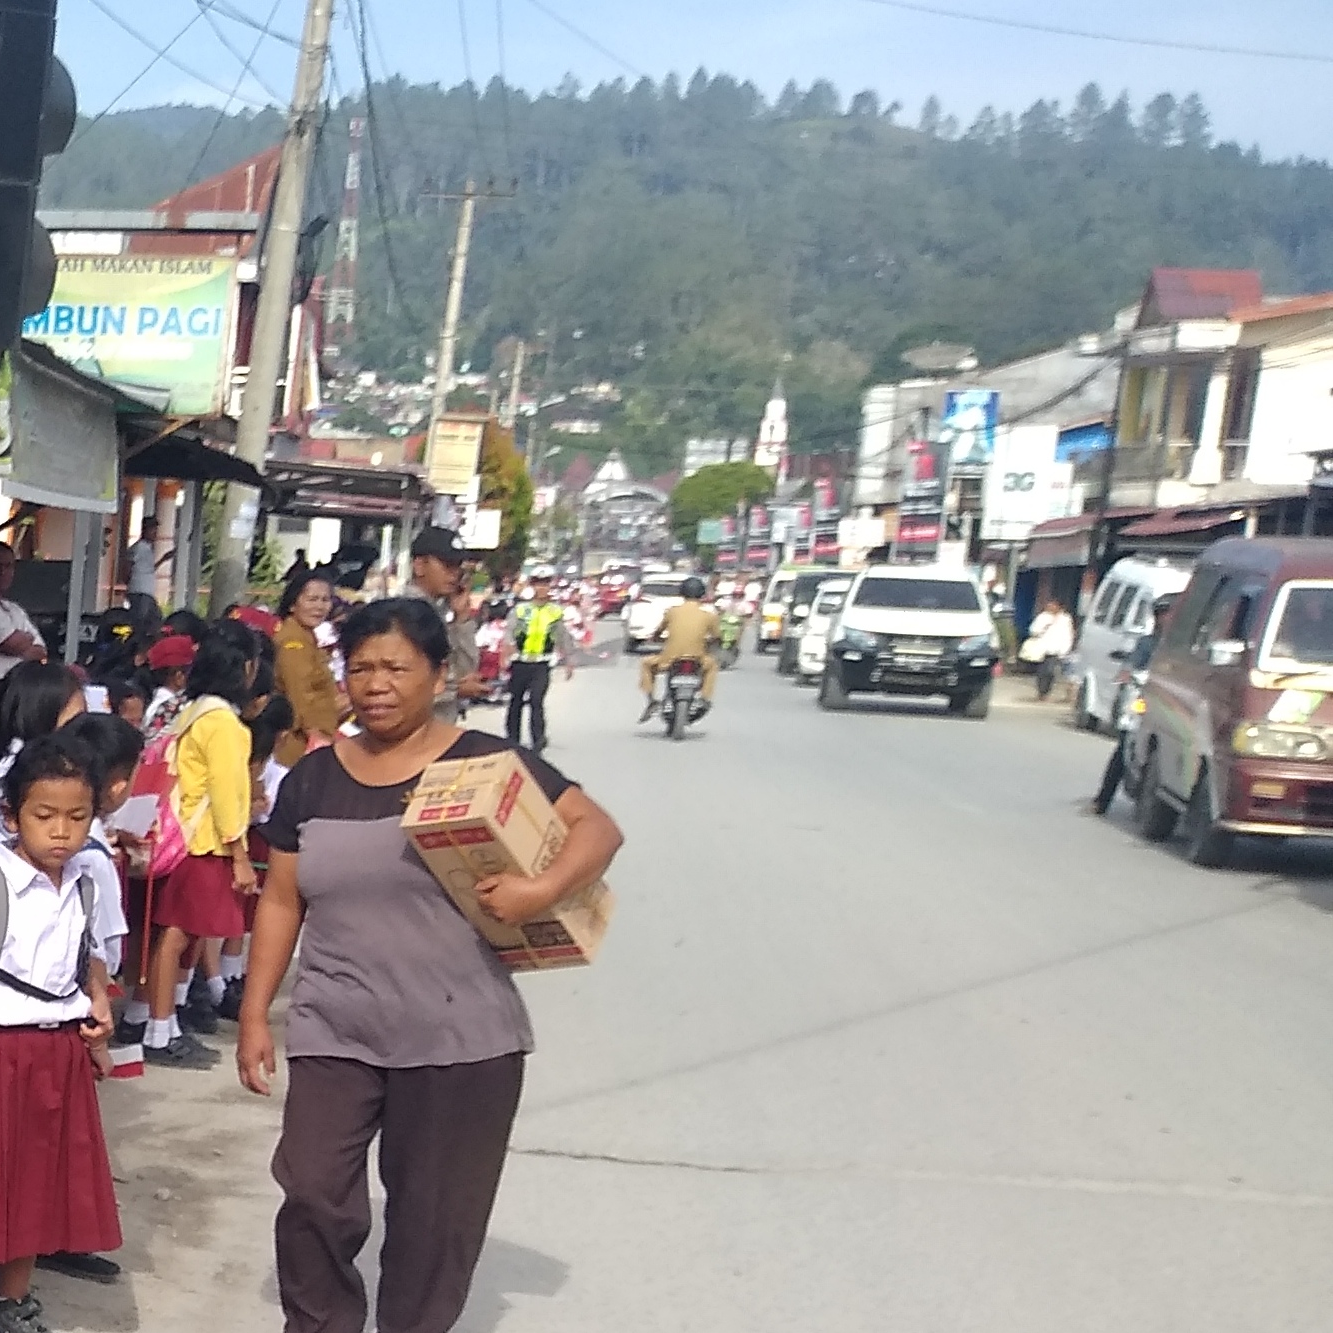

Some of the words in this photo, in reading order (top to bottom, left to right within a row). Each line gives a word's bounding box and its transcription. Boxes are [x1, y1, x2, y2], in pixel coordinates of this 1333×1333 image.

[57, 258, 85, 273] AH
[92, 259, 153, 274] MAKAN
[159, 260, 212, 275] ISLAM
[22, 304, 127, 336] MBUN
[136, 306, 222, 337] PAGI
